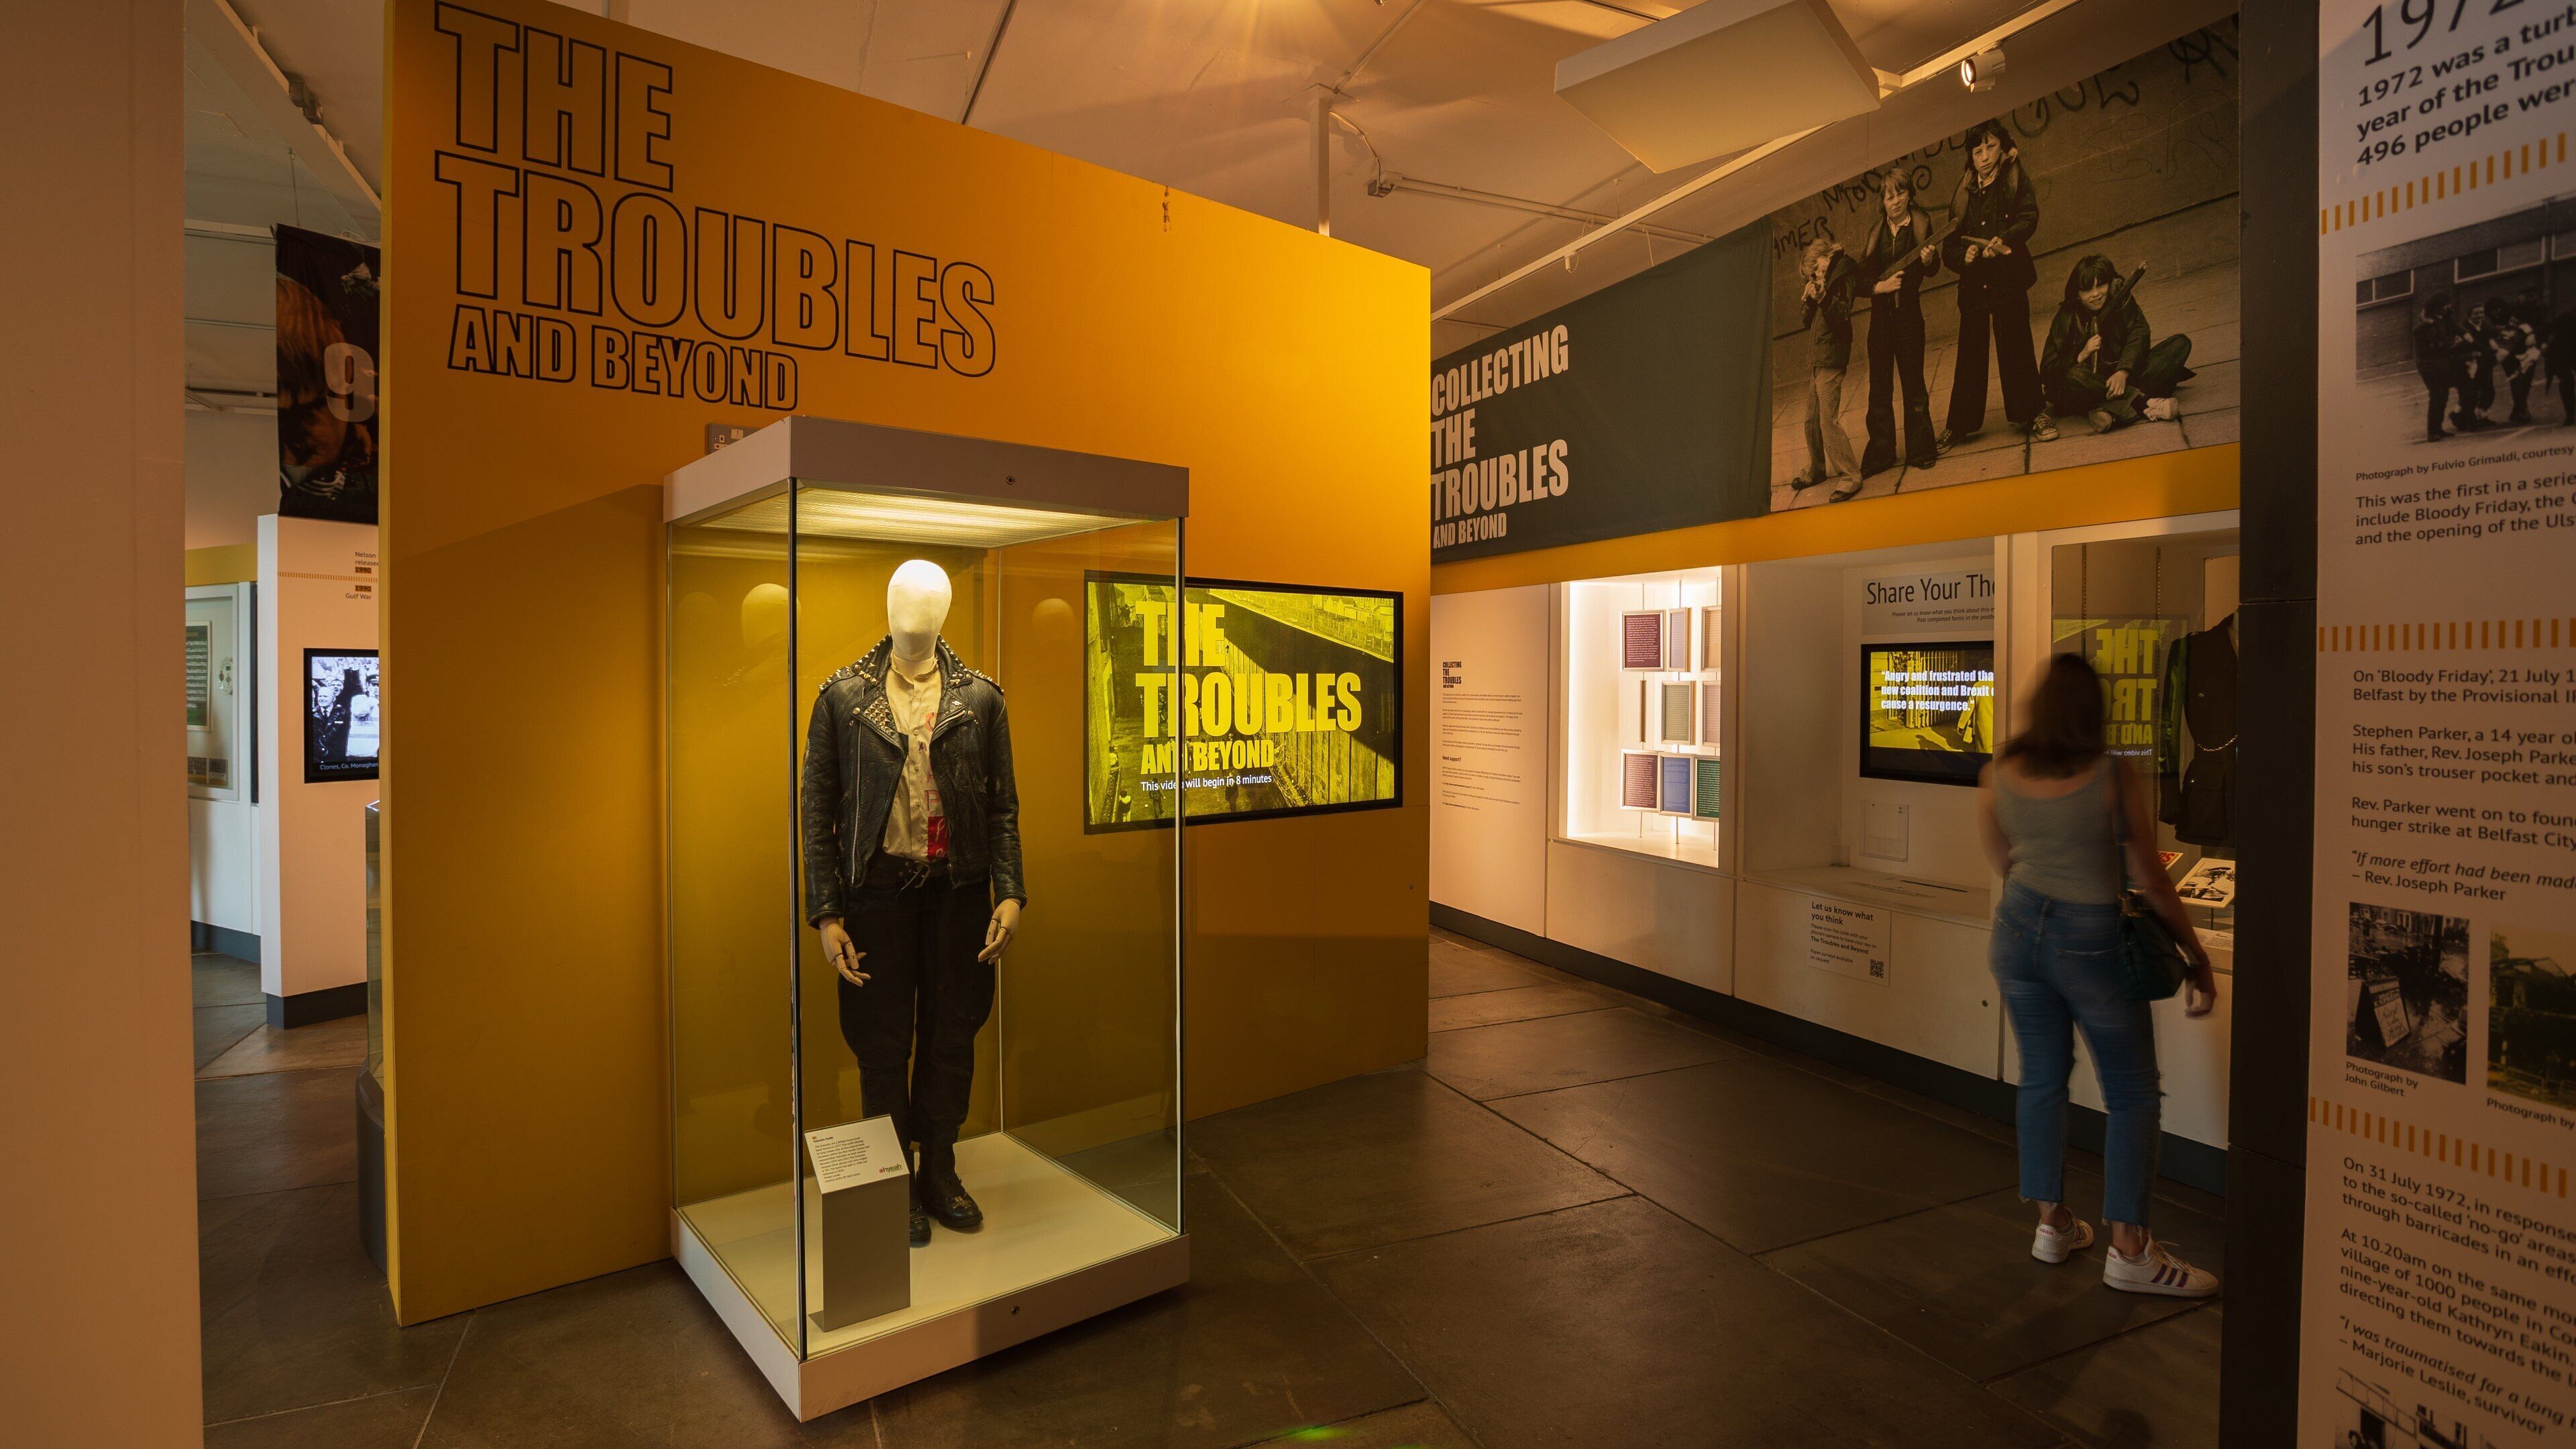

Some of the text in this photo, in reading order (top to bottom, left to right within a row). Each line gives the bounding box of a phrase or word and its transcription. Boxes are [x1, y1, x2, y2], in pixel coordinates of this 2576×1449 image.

[2362, 0, 2527, 66] 19
[2359, 66, 2422, 107] 1972
[2432, 46, 2484, 78] was
[2494, 36, 2510, 54] a
[435, 0, 673, 193] THE
[2357, 45, 2574, 142] year of the Trou
[2357, 134, 2405, 165] 496
[2416, 103, 2508, 153] people
[435, 151, 996, 378] TROUBLES
[447, 305, 798, 411] AND BEYOND
[1432, 325, 1568, 416] COLLECTING
[323, 342, 375, 422] 9
[1431, 408, 1476, 468] THE
[1431, 439, 1568, 521] TROUBLES
[2355, 445, 2574, 481] Photograph by Fulvio Grimaldi, courtesy
[2355, 494, 2385, 508] This
[2391, 493, 2420, 504] was
[2426, 488, 2451, 501] the
[2457, 483, 2489, 498] first
[2496, 480, 2510, 493] in
[2518, 480, 2526, 491] a
[1433, 513, 1507, 548] AND BEYOND
[1867, 574, 1994, 605] Share Your Th
[1136, 601, 1226, 667] THE
[1881, 671, 1910, 682] "Angry
[1911, 671, 1927, 681] and
[1929, 670, 1976, 682] frustrated
[1881, 685, 1989, 696] new coalition and Brexit
[2354, 670, 2373, 682] On
[2378, 669, 2433, 685] 'Bloody
[2499, 669, 2518, 683] 21
[2525, 669, 2559, 686] July
[1136, 672, 1362, 738] TROUBLES
[1881, 700, 1974, 711] cause a resurgence."
[2354, 688, 2558, 704] Belfast by the Provisional
[2353, 724, 2555, 745] Stephen Parker, a 14 year
[1193, 740, 1274, 771] BEYOND
[1140, 782, 1159, 791] This
[1186, 778, 1200, 788] will
[1203, 777, 1224, 789] begin
[1226, 777, 1234, 786] in
[1236, 775, 1241, 785] 8
[1242, 775, 1272, 784] minutes
[2365, 870, 2506, 901] Rev. Joseph Parker
[1812, 902, 1823, 910] Let
[1834, 907, 1853, 916] know
[1856, 912, 1873, 921] what
[1825, 916, 1843, 924] think
[1821, 938, 1840, 947] Troubles
[1851, 946, 1868, 955] Beyond
[2345, 1073, 2404, 1097] John Gilbert
[2347, 1061, 2418, 1089] Photograph by
[2487, 1097, 2575, 1130] Photograph by
[2344, 1157, 2576, 1243] On 31 July 1972, in response
[2341, 1228, 2536, 1311] At 10.20am on the same
[2353, 1339, 2544, 1435] Marjorie Leslie, survivor
